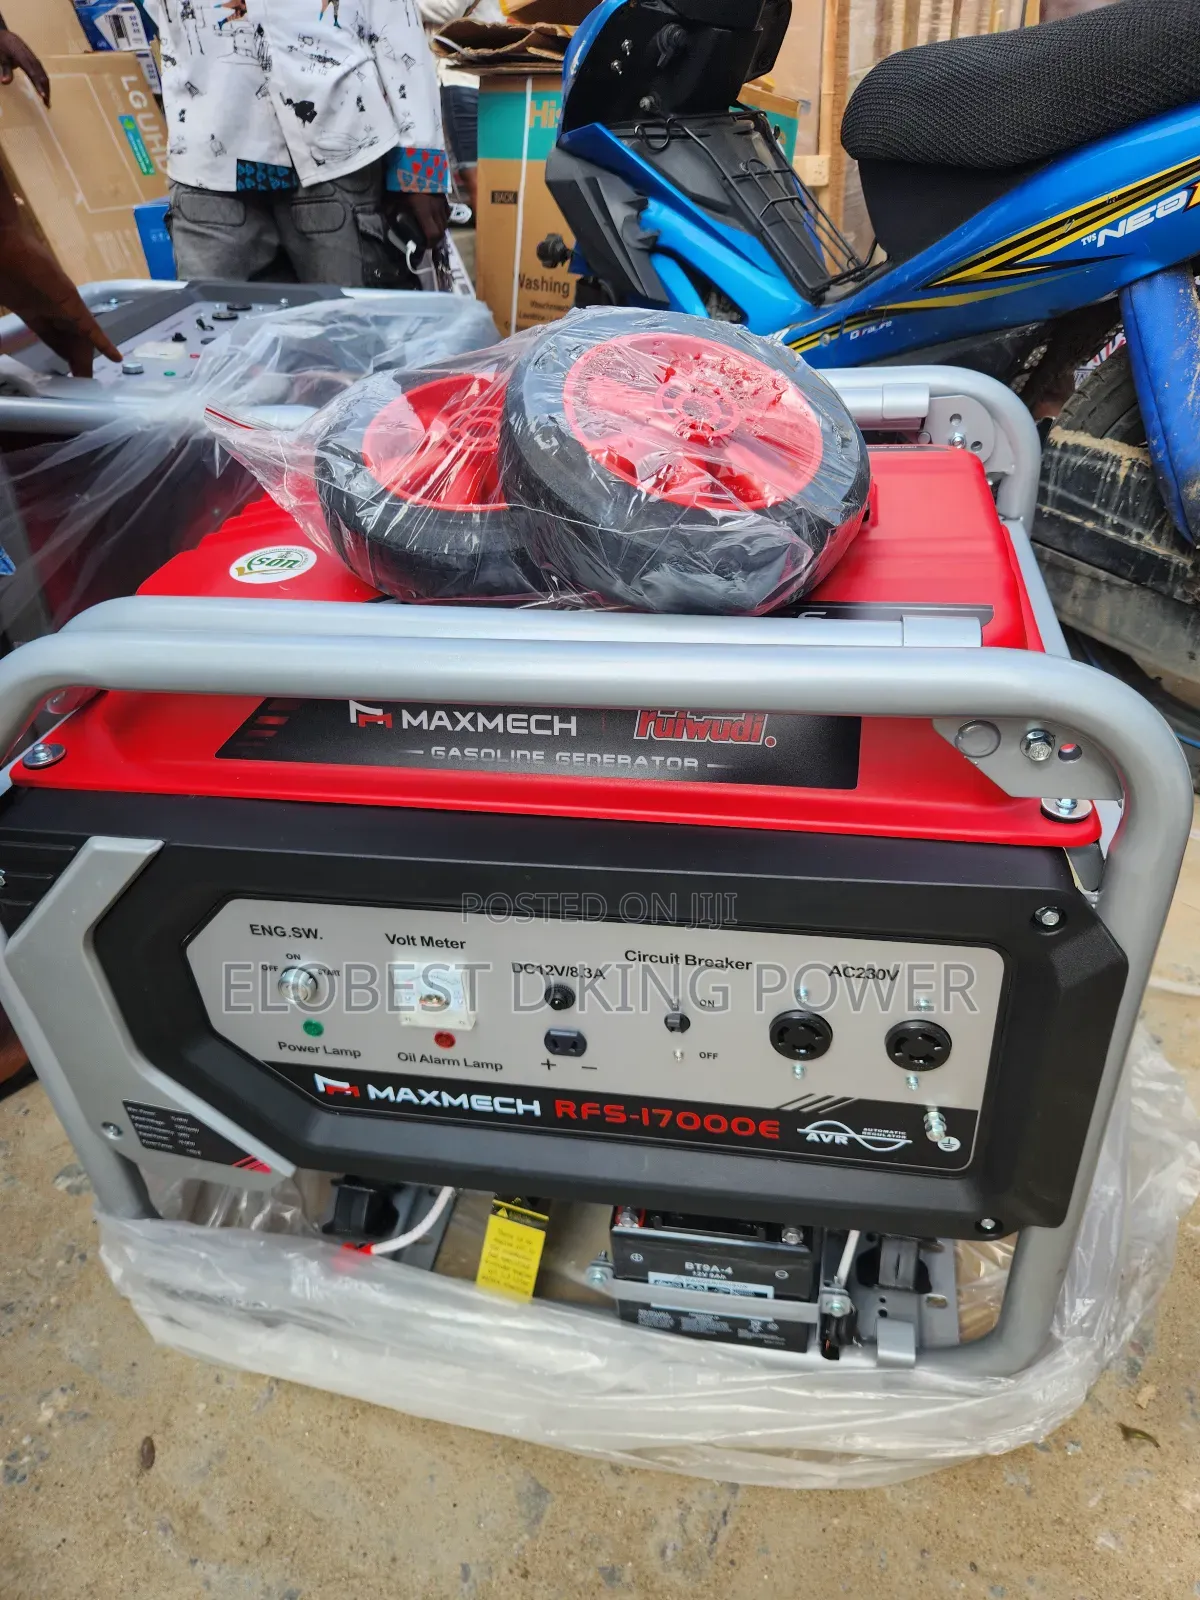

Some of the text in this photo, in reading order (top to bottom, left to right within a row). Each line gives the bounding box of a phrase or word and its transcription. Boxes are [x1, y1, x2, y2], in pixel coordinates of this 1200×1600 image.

[120, 75, 148, 110] LG
[1080, 190, 1188, 248] TVS NEO
[402, 709, 577, 737] MAXMECH
[431, 746, 699, 771] GASOLINE GENERATOR
[249, 924, 323, 940] ENG.SW.
[385, 933, 466, 949] Volt Meter
[285, 953, 301, 961] ON
[624, 950, 753, 971] Circuit Breaker
[261, 964, 279, 972] OFF
[317, 969, 340, 977] START
[511, 962, 606, 980] DC12V/8.3A
[828, 965, 899, 982] AC230V
[699, 999, 715, 1008] ON
[278, 1041, 361, 1059] Power Lamp
[699, 1051, 719, 1060] OFF
[397, 1051, 503, 1072] Oil Alarm Lamp
[367, 1083, 780, 1139] MAXMECH RFS-17000E
[805, 1132, 849, 1146] AVR
[862, 1127, 907, 1136] AUTOMATIC
